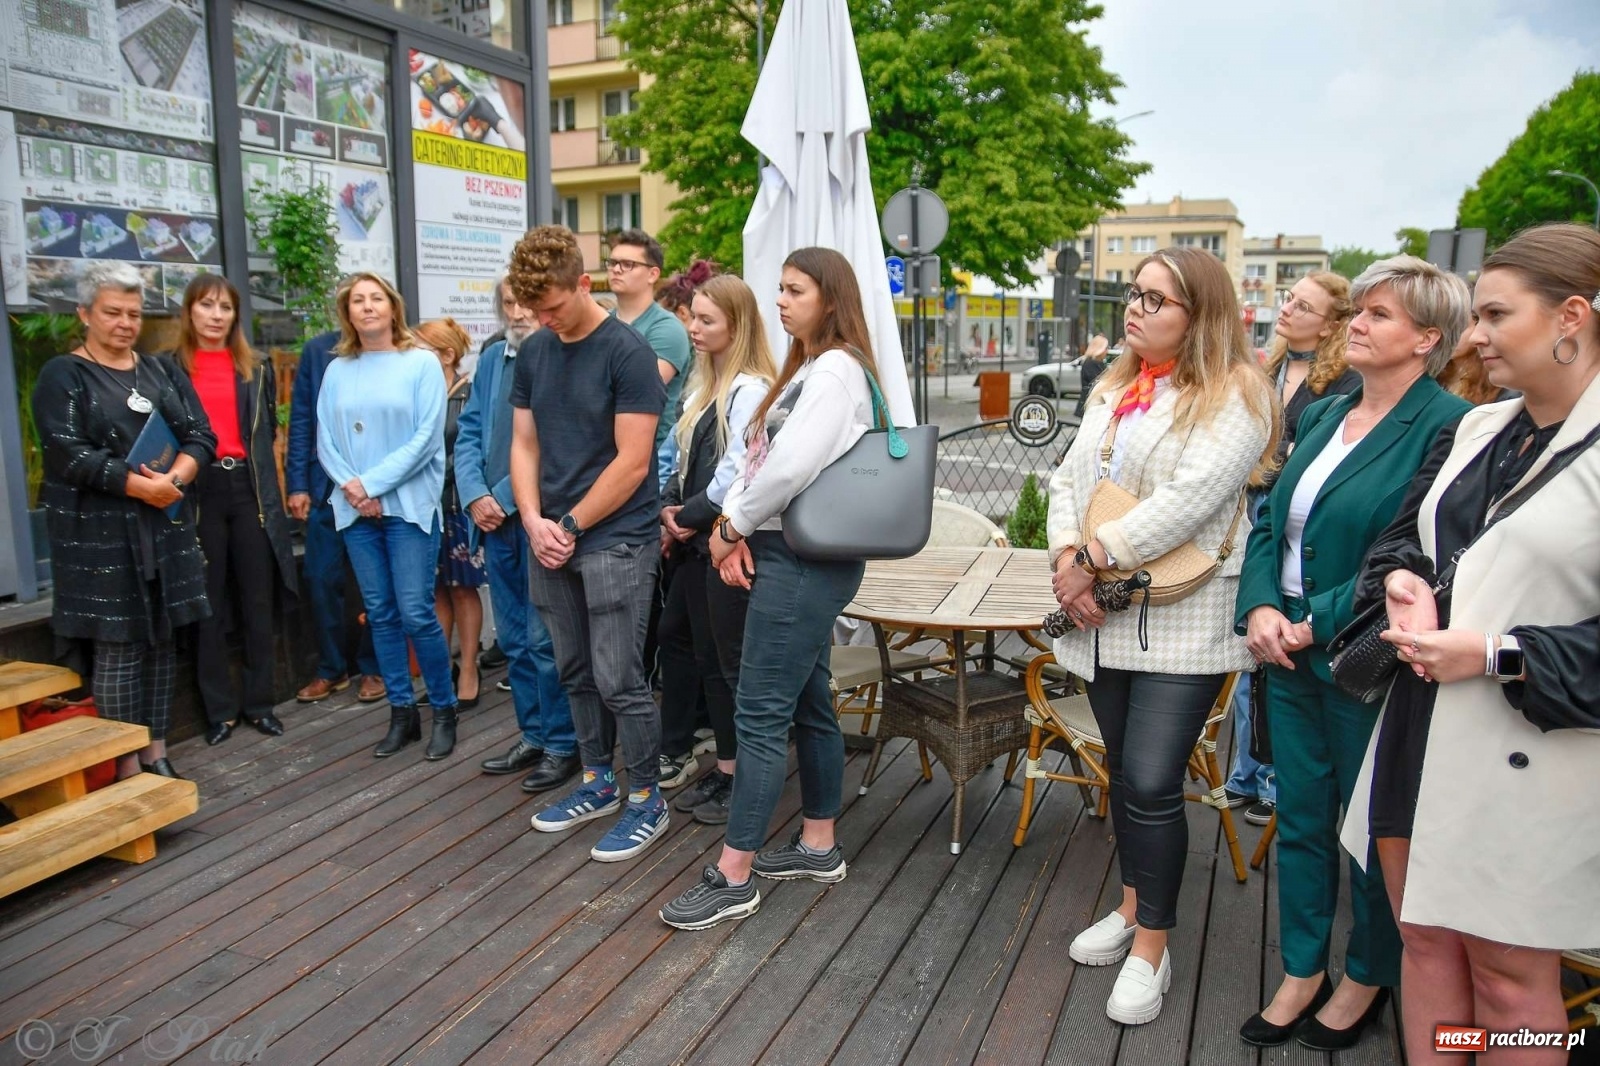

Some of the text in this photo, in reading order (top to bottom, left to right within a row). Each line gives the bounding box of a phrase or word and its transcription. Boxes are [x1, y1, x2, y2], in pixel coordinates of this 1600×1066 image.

[415, 136, 524, 178] CATERING DIETETYCZNY
[465, 176, 522, 199] BEZ PSZENICY
